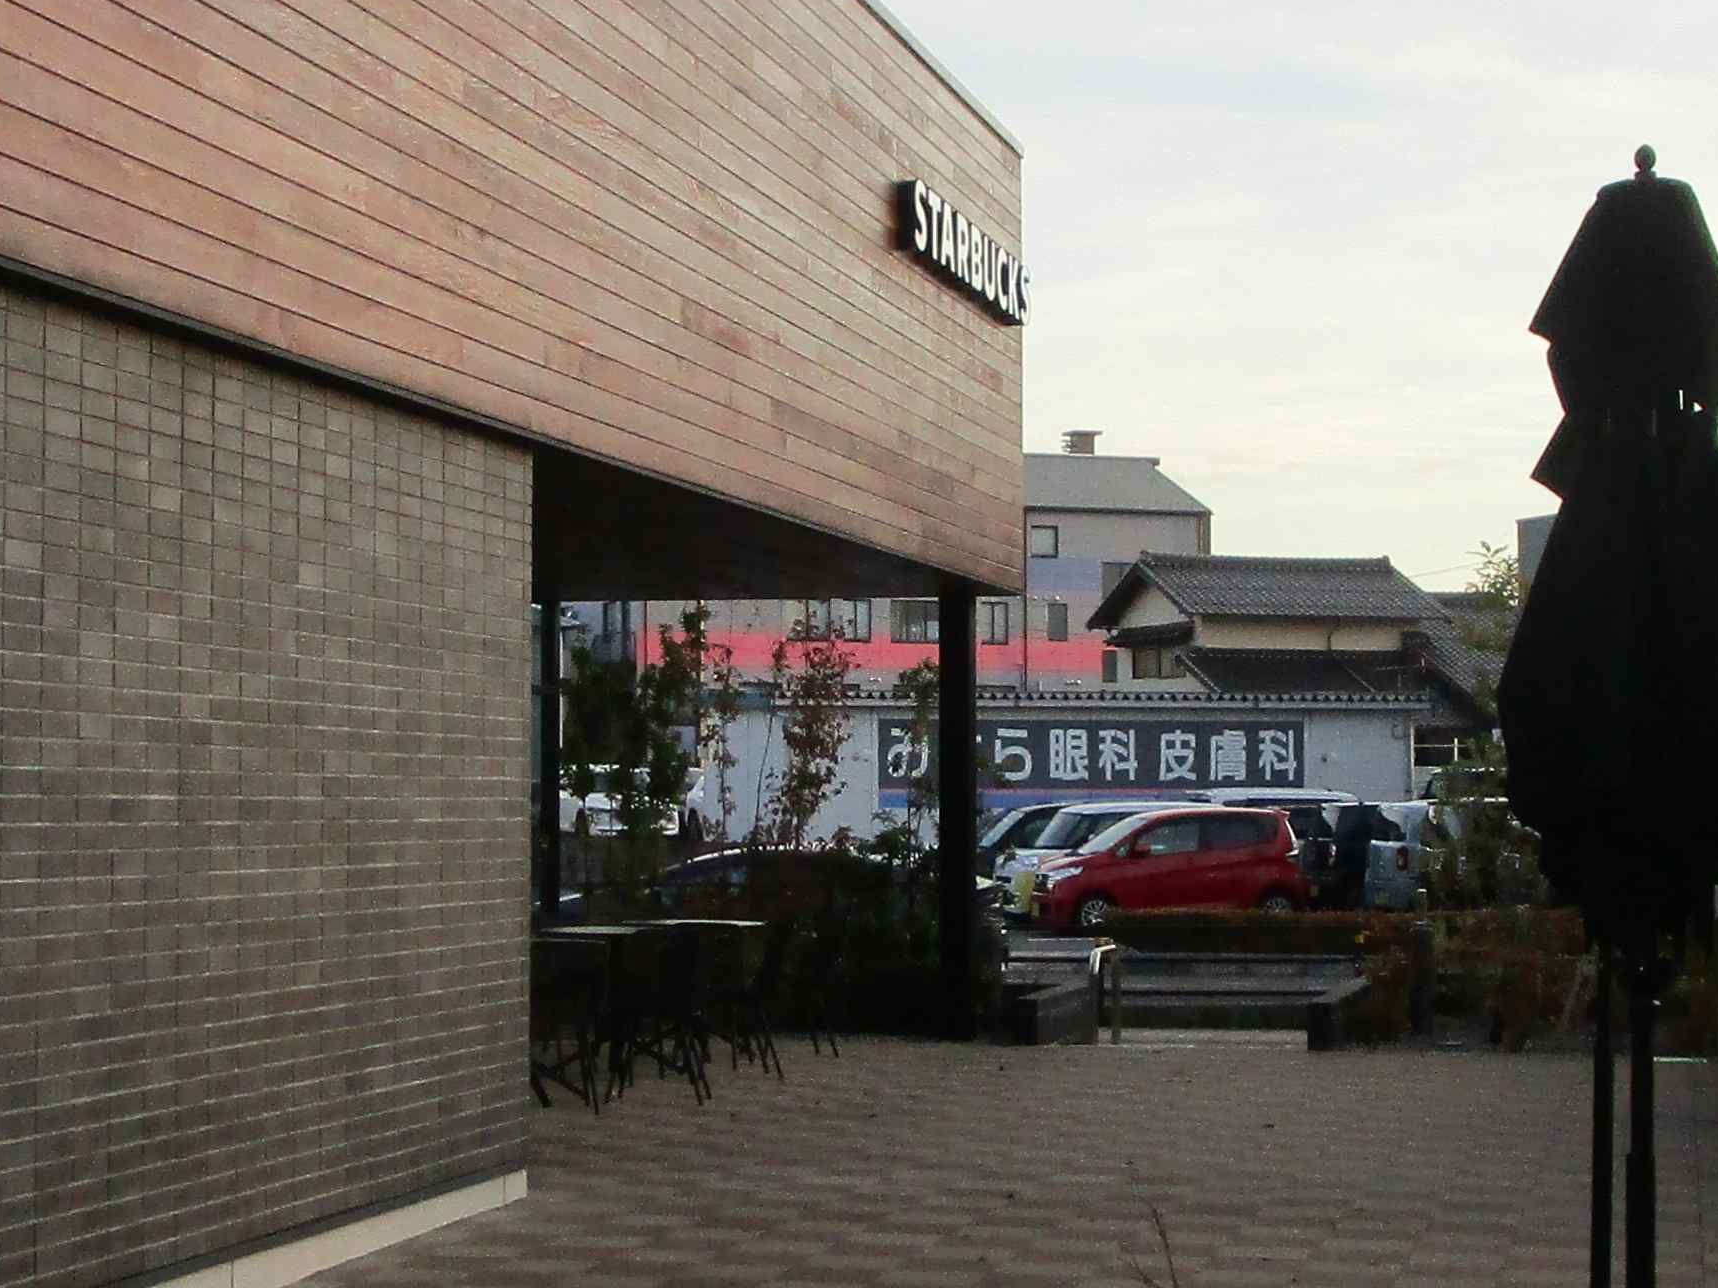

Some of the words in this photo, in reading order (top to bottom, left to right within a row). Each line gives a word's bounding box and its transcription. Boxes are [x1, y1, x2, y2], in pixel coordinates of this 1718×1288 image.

[914, 179, 1031, 326] STARBUCKS
[887, 727, 1138, 782] みら眼科
